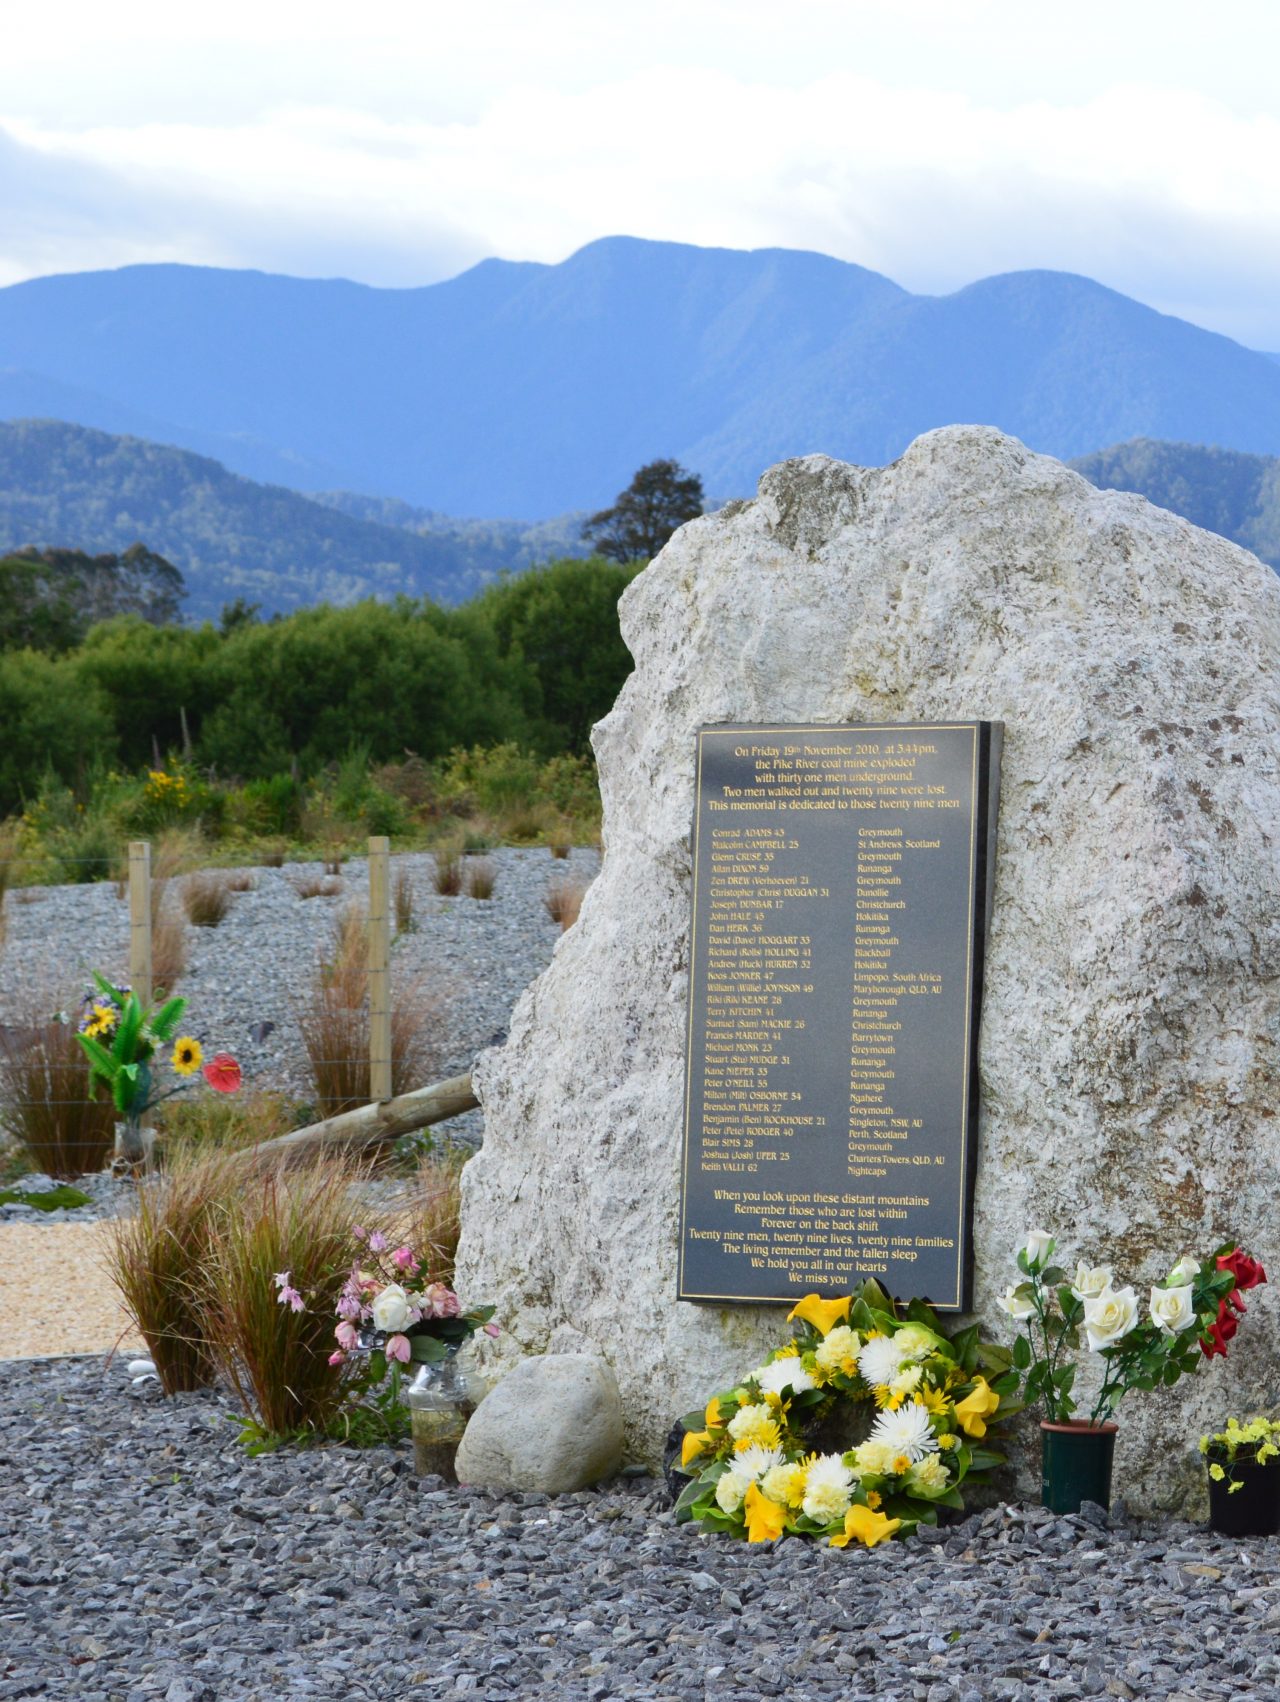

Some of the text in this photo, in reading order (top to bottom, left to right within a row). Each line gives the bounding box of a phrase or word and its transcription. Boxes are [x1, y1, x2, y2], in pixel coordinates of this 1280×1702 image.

[735, 747, 749, 757] On
[751, 746, 780, 758] Friday
[804, 746, 852, 755] November
[884, 744, 894, 754] at
[755, 757, 916, 770] the Pike River coal mine exploded
[755, 773, 775, 783] with
[777, 773, 802, 784] thirty
[804, 774, 823, 782] one
[825, 774, 846, 782] men
[723, 786, 742, 797] Two
[744, 788, 765, 796] men
[767, 786, 801, 796] walked
[803, 787, 819, 796] out
[821, 786, 840, 796] and
[842, 786, 874, 798] twenty
[876, 786, 898, 795] nine
[900, 786, 924, 794] were
[708, 798, 960, 810] This memorial is dedicated to those twenty nine men
[858, 828, 903, 838] Greymouth
[905, 839, 940, 848] Scotland
[857, 852, 902, 862] Greymouth
[857, 864, 892, 874] Runanga
[856, 876, 901, 887] Greymouth
[710, 888, 754, 898] Christopher
[856, 888, 889, 897] Dunollie
[856, 900, 906, 909] Christchurch
[856, 912, 889, 921] Hokitika
[855, 925, 890, 935] Runanga
[855, 937, 899, 947] Greymouth
[854, 949, 891, 957] Blackball
[854, 961, 887, 969] Hokitika
[892, 973, 916, 981] South
[918, 973, 942, 982] Africa
[930, 985, 942, 994] AU
[853, 996, 897, 1008] Greymouth
[852, 1009, 888, 1019] Runanga
[852, 1021, 902, 1030] Christchurch
[852, 1033, 893, 1043] Barrytown
[851, 1045, 896, 1056] Greymouth
[850, 1057, 886, 1068] Runanga
[850, 1070, 895, 1080] Greymouth
[850, 1082, 885, 1093] Runanga
[850, 1094, 883, 1104] Ngahere
[849, 1105, 894, 1116] Greymouth
[703, 1115, 739, 1125] Benjamin
[764, 1116, 813, 1125] ROCKHOUSE
[911, 1119, 923, 1128] AU
[702, 1126, 721, 1135] Peter
[873, 1130, 908, 1139] Scotland
[848, 1142, 893, 1152] Greymouth
[701, 1150, 729, 1159] Joshua
[847, 1154, 882, 1163] Charters
[934, 1156, 945, 1165] AU
[847, 1166, 887, 1177] Nightcaps
[714, 1190, 930, 1206] When you look upon these distant mountains
[734, 1203, 908, 1219] Remember those who are lost within
[761, 1218, 879, 1231] Forever on the back shift
[689, 1228, 954, 1248] Twenty nine men, twenty nine lives, twenty nine families
[722, 1243, 918, 1261] The living remember and the fallen sleep
[751, 1257, 887, 1272] We hold you all in our hearts
[788, 1272, 848, 1286] We miss you
